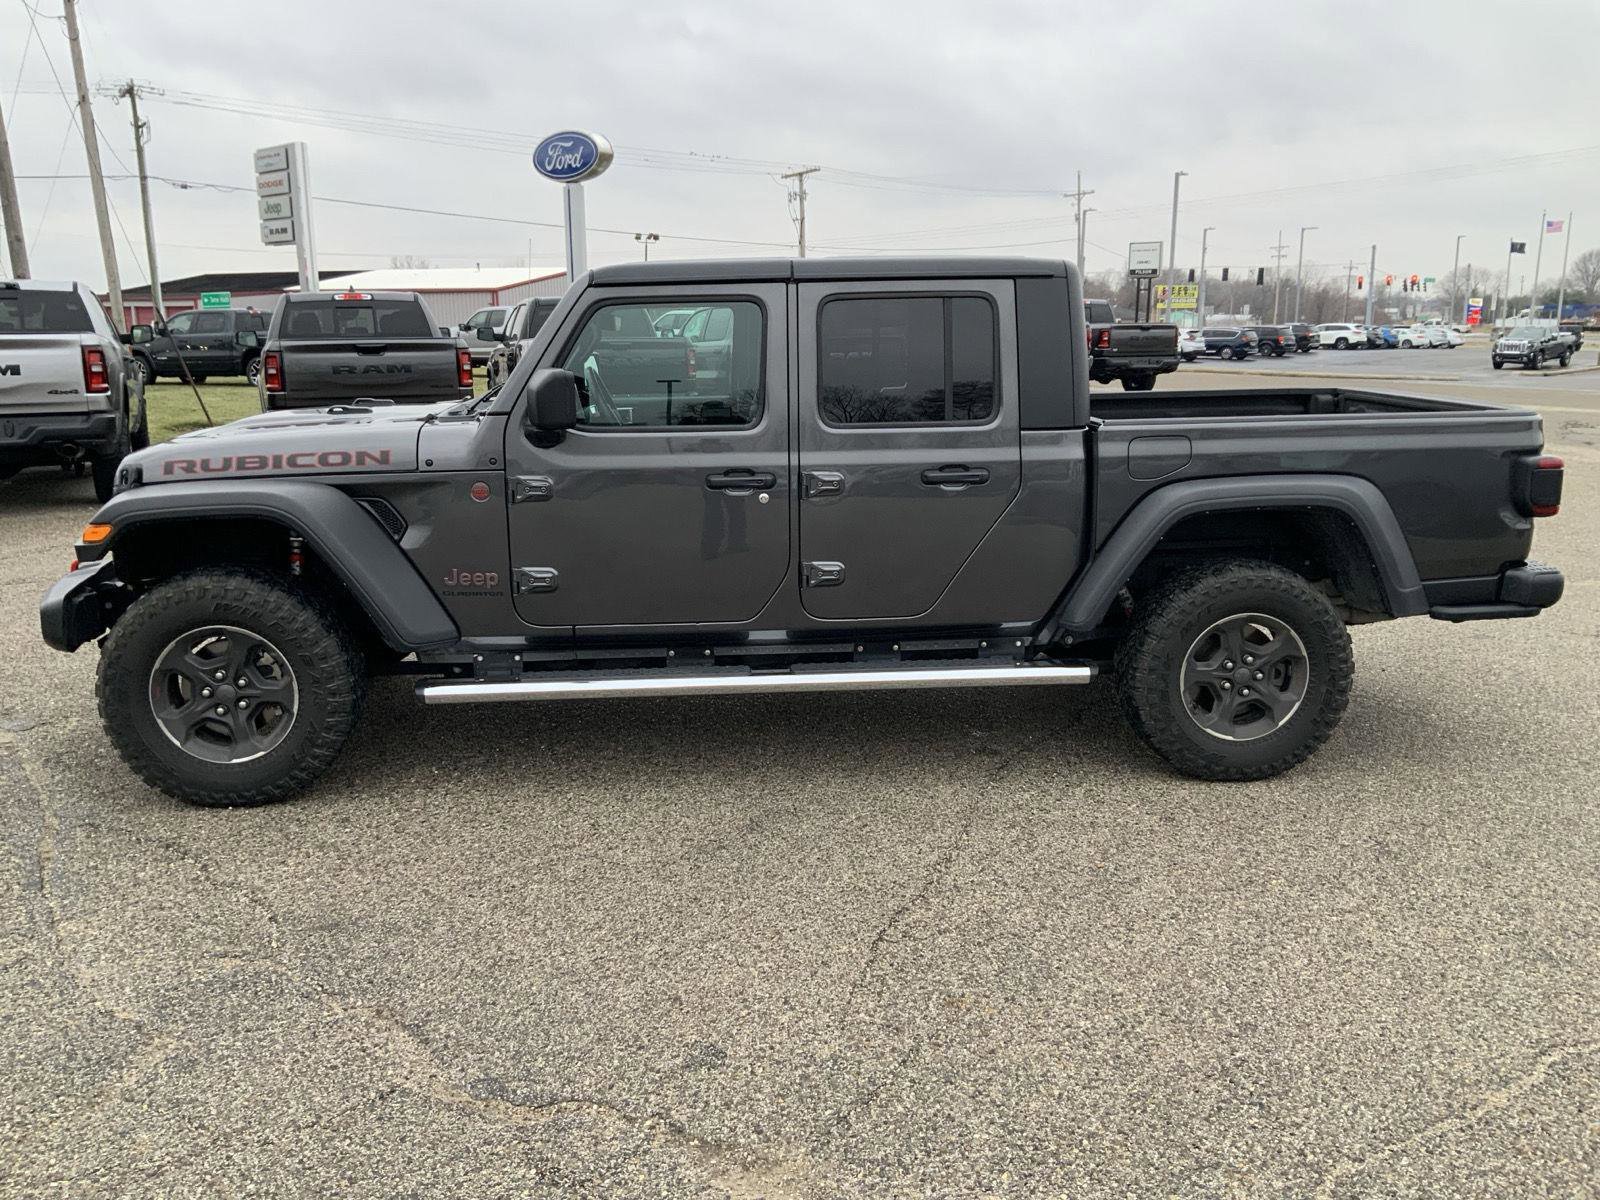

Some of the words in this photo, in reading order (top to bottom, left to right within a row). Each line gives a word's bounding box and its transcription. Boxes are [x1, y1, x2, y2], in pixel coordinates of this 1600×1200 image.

[545, 141, 583, 171] Ford
[259, 179, 284, 189] DODGE
[264, 201, 282, 215] Jeep
[269, 227, 288, 236] RAM
[332, 364, 413, 375] RAM
[163, 450, 391, 476] RUBICON
[444, 568, 499, 589] Jeep
